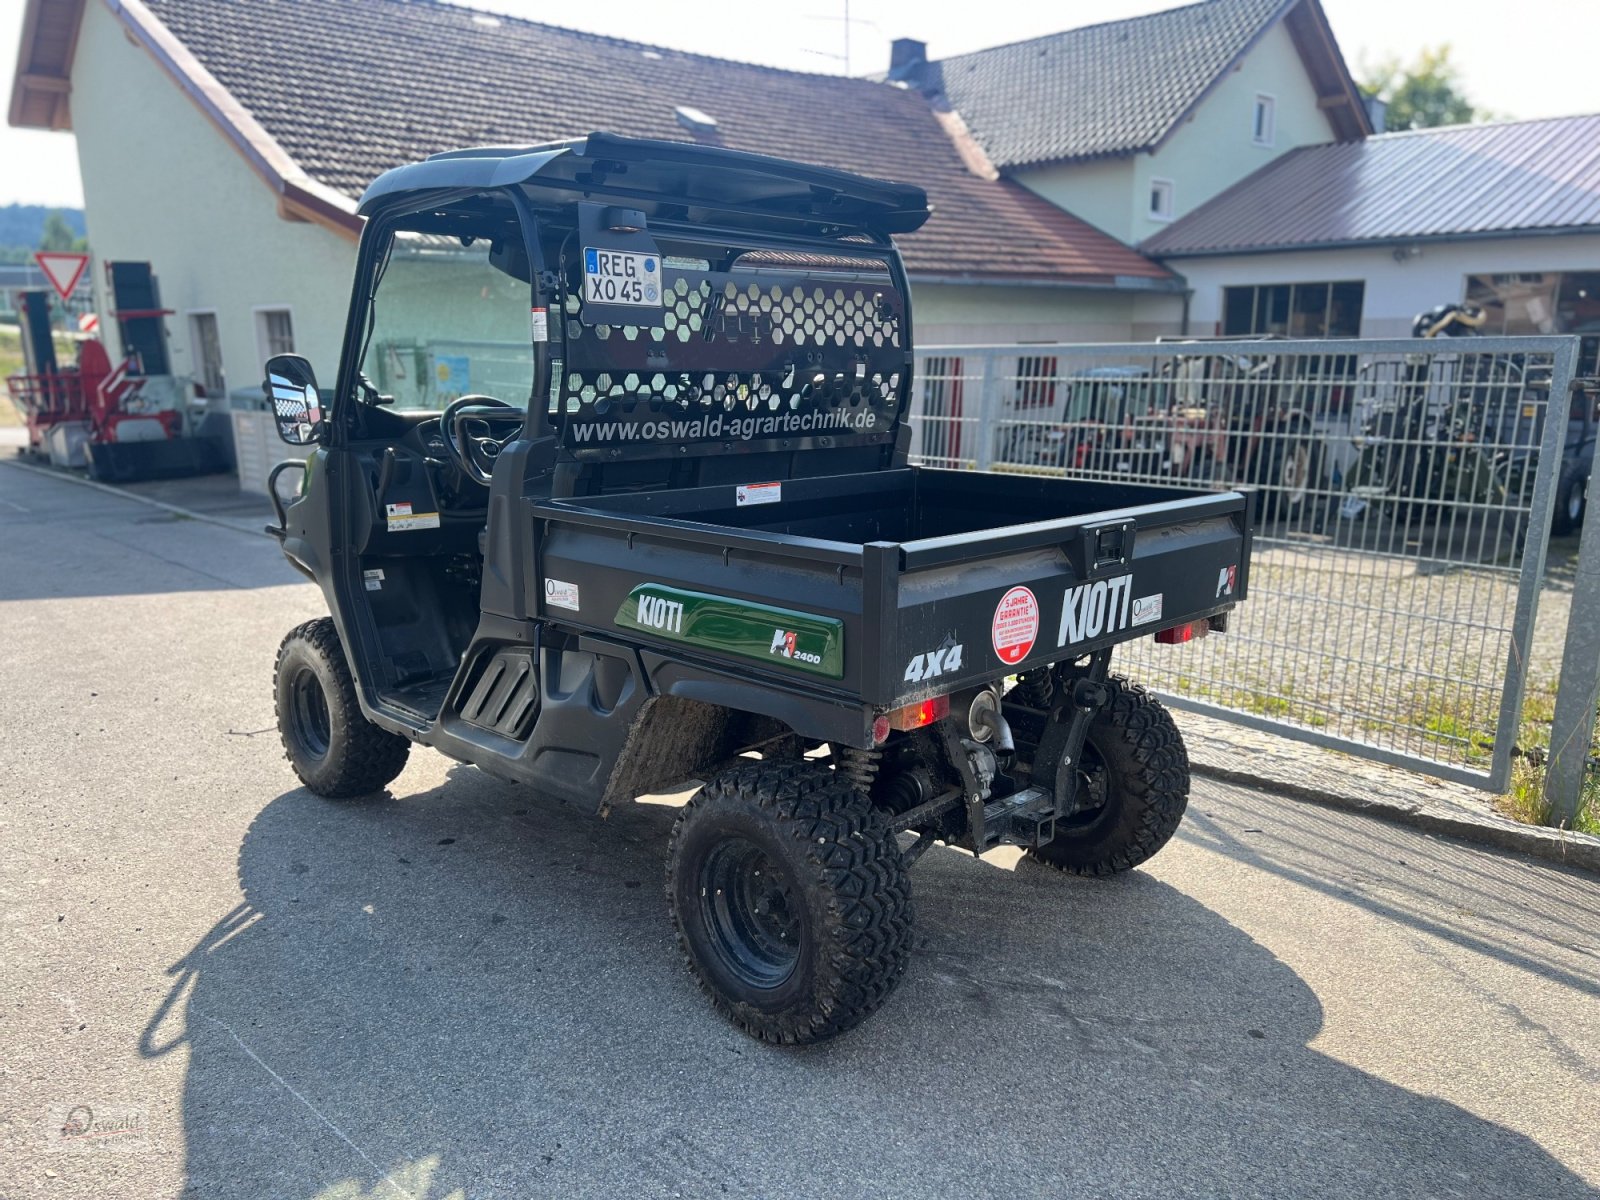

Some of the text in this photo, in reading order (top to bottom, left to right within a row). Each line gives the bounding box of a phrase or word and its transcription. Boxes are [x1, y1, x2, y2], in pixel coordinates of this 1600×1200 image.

[599, 253, 636, 278] REG
[592, 278, 642, 302] XO 45
[572, 408, 876, 441] www.oswald-agrartechnik.de
[1010, 595, 1029, 606] JAHRE
[1057, 574, 1133, 647] KIOTI
[637, 594, 684, 633] KIOTI
[793, 650, 821, 664] 2400
